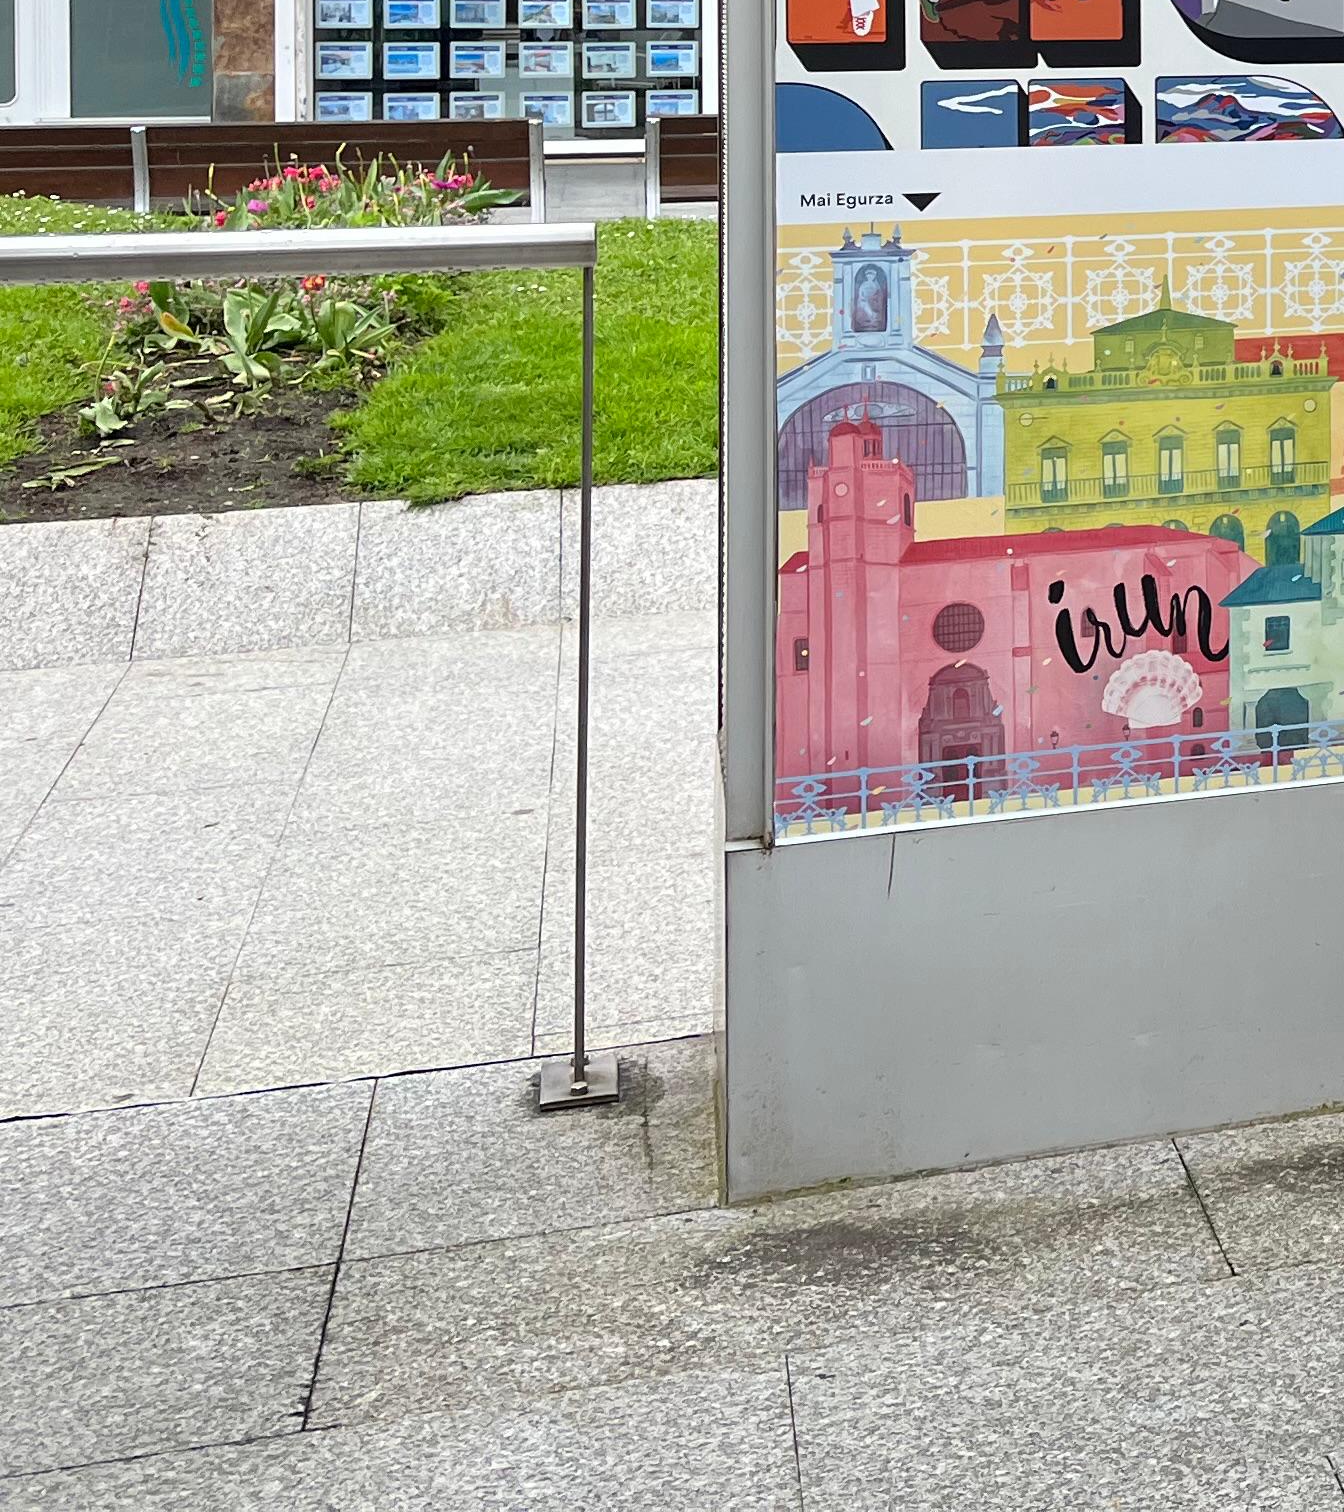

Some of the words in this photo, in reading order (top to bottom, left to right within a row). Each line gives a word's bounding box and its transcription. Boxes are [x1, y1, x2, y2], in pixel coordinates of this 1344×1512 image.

[800, 192, 831, 208] Mai
[836, 192, 894, 209] Egurza
[1047, 573, 1230, 674] irun
